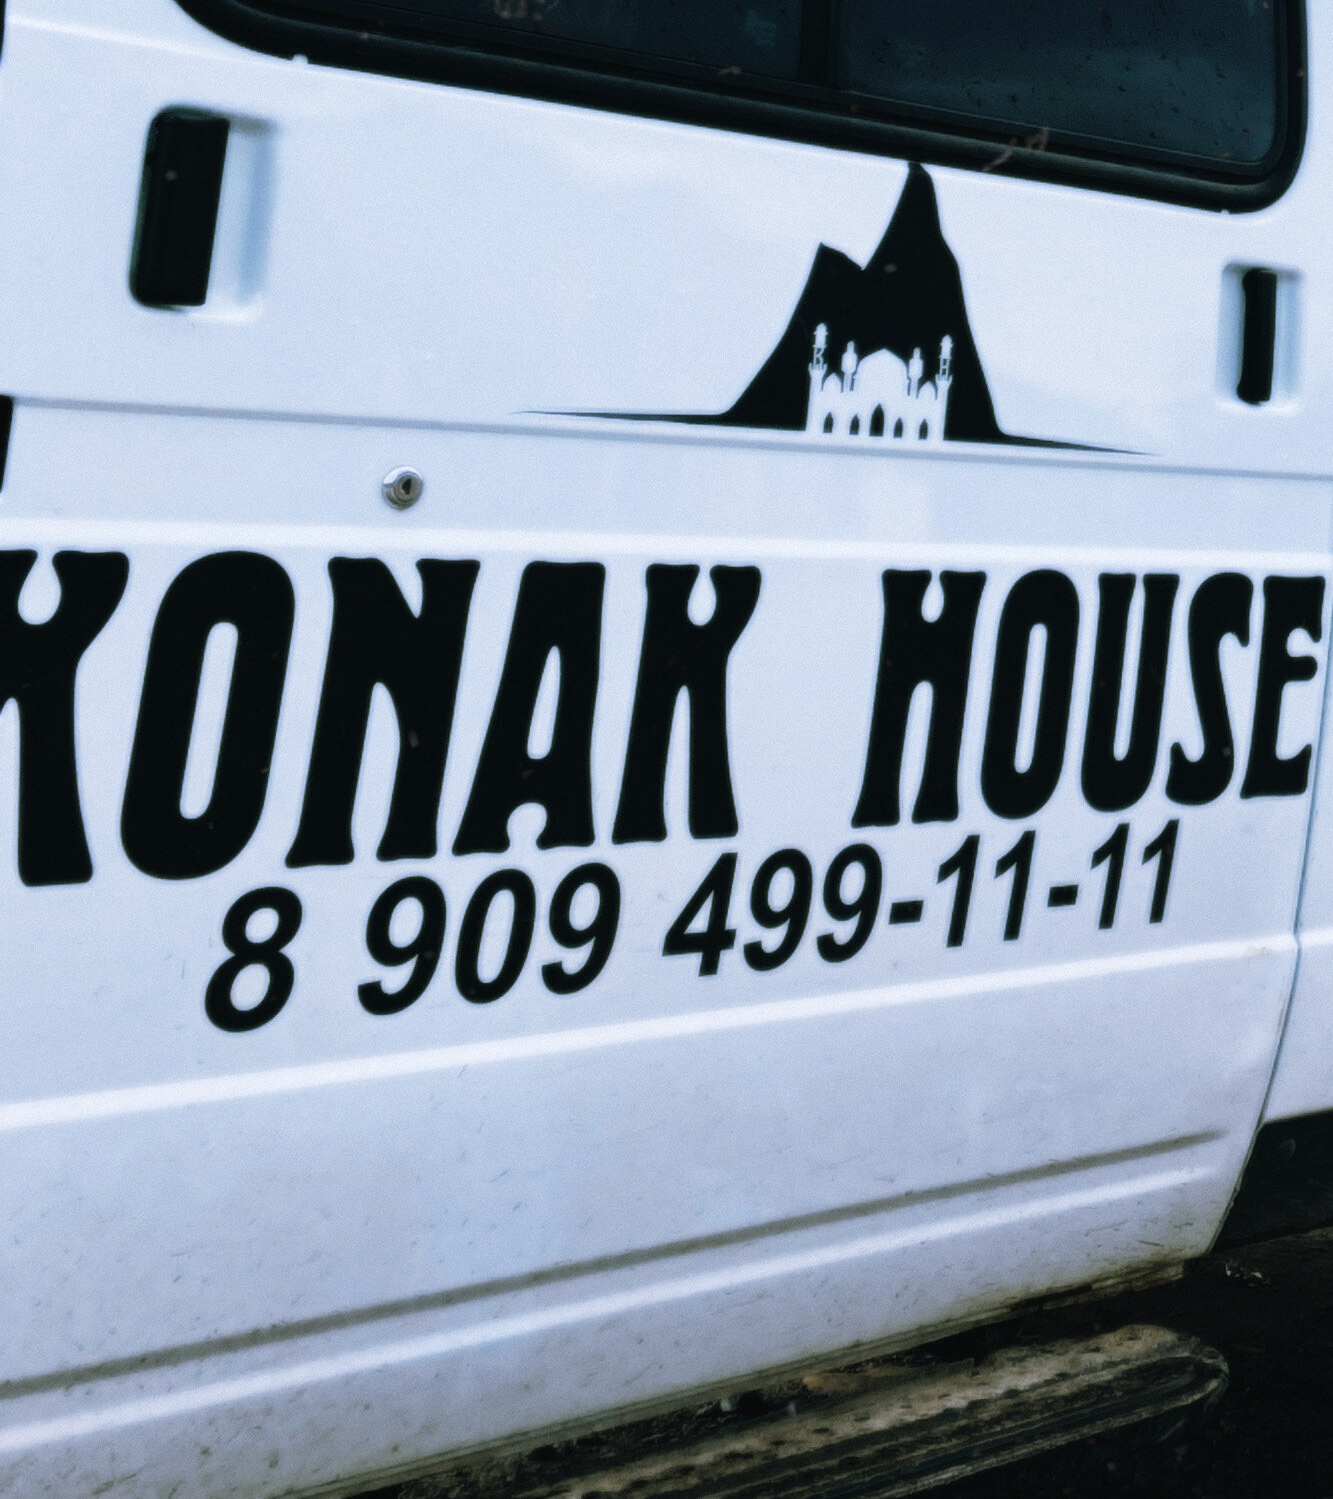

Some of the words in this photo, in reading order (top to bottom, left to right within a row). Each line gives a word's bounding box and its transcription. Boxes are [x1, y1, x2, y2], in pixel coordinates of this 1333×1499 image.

[0, 549, 762, 888] KONAK
[850, 568, 1326, 829] HOUSE
[204, 886, 303, 1033] 8
[357, 862, 621, 1016] 909
[662, 819, 1180, 977] 499-11-11
